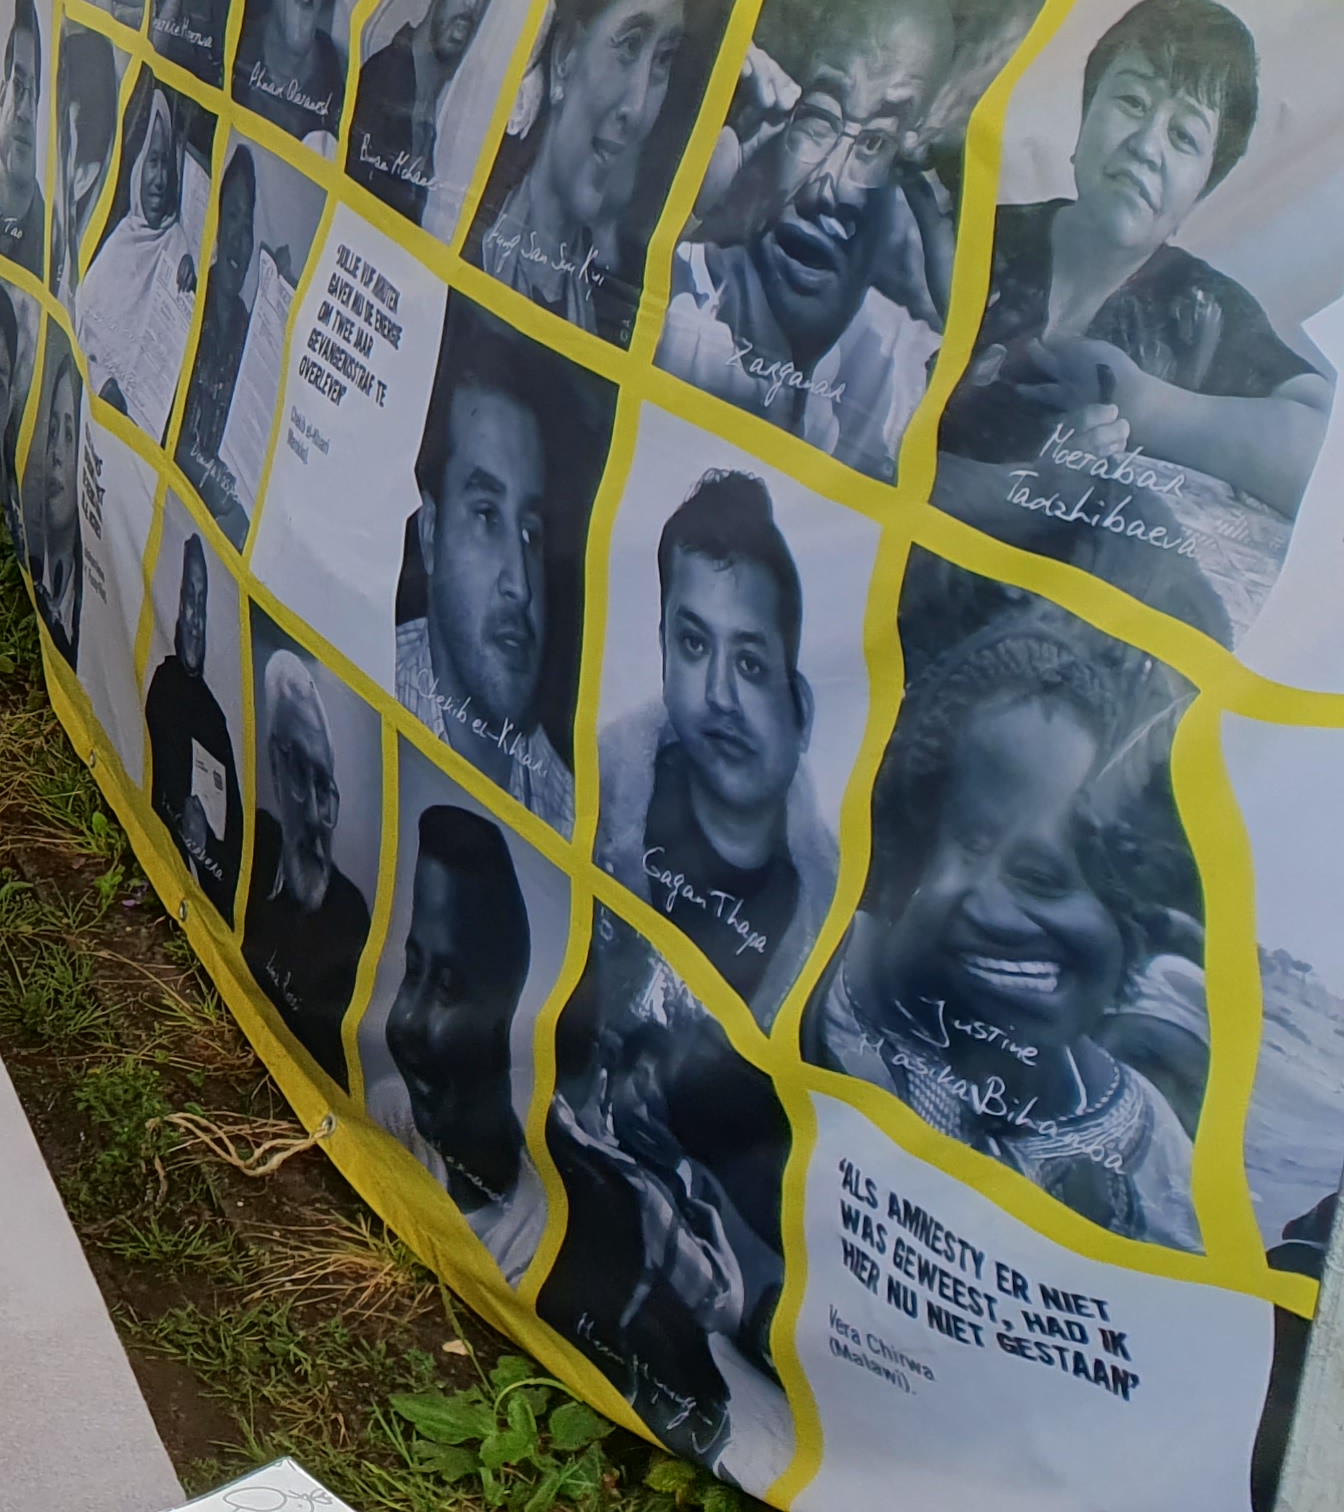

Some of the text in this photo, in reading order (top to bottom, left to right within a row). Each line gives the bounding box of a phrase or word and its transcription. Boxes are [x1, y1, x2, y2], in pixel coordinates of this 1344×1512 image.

[3, 217, 23, 239] Tao
[317, 300, 333, 328] OM
[331, 311, 355, 345] TWEE
[375, 378, 388, 408] TE
[642, 846, 767, 956] Gagan Thapa
[910, 995, 1039, 1067] Justine
[840, 1199, 887, 1255] WAS
[1020, 1310, 1090, 1346] HAD
[1097, 1327, 1132, 1362] IK
[841, 1237, 881, 1296] HIER
[886, 1276, 918, 1320] NU
[926, 1299, 986, 1349] NIET
[887, 1191, 986, 1281] AMNESTY
[994, 1260, 1032, 1305] ER
[1039, 1283, 1111, 1323] NIET
[828, 1304, 936, 1382] Vera Chirwa
